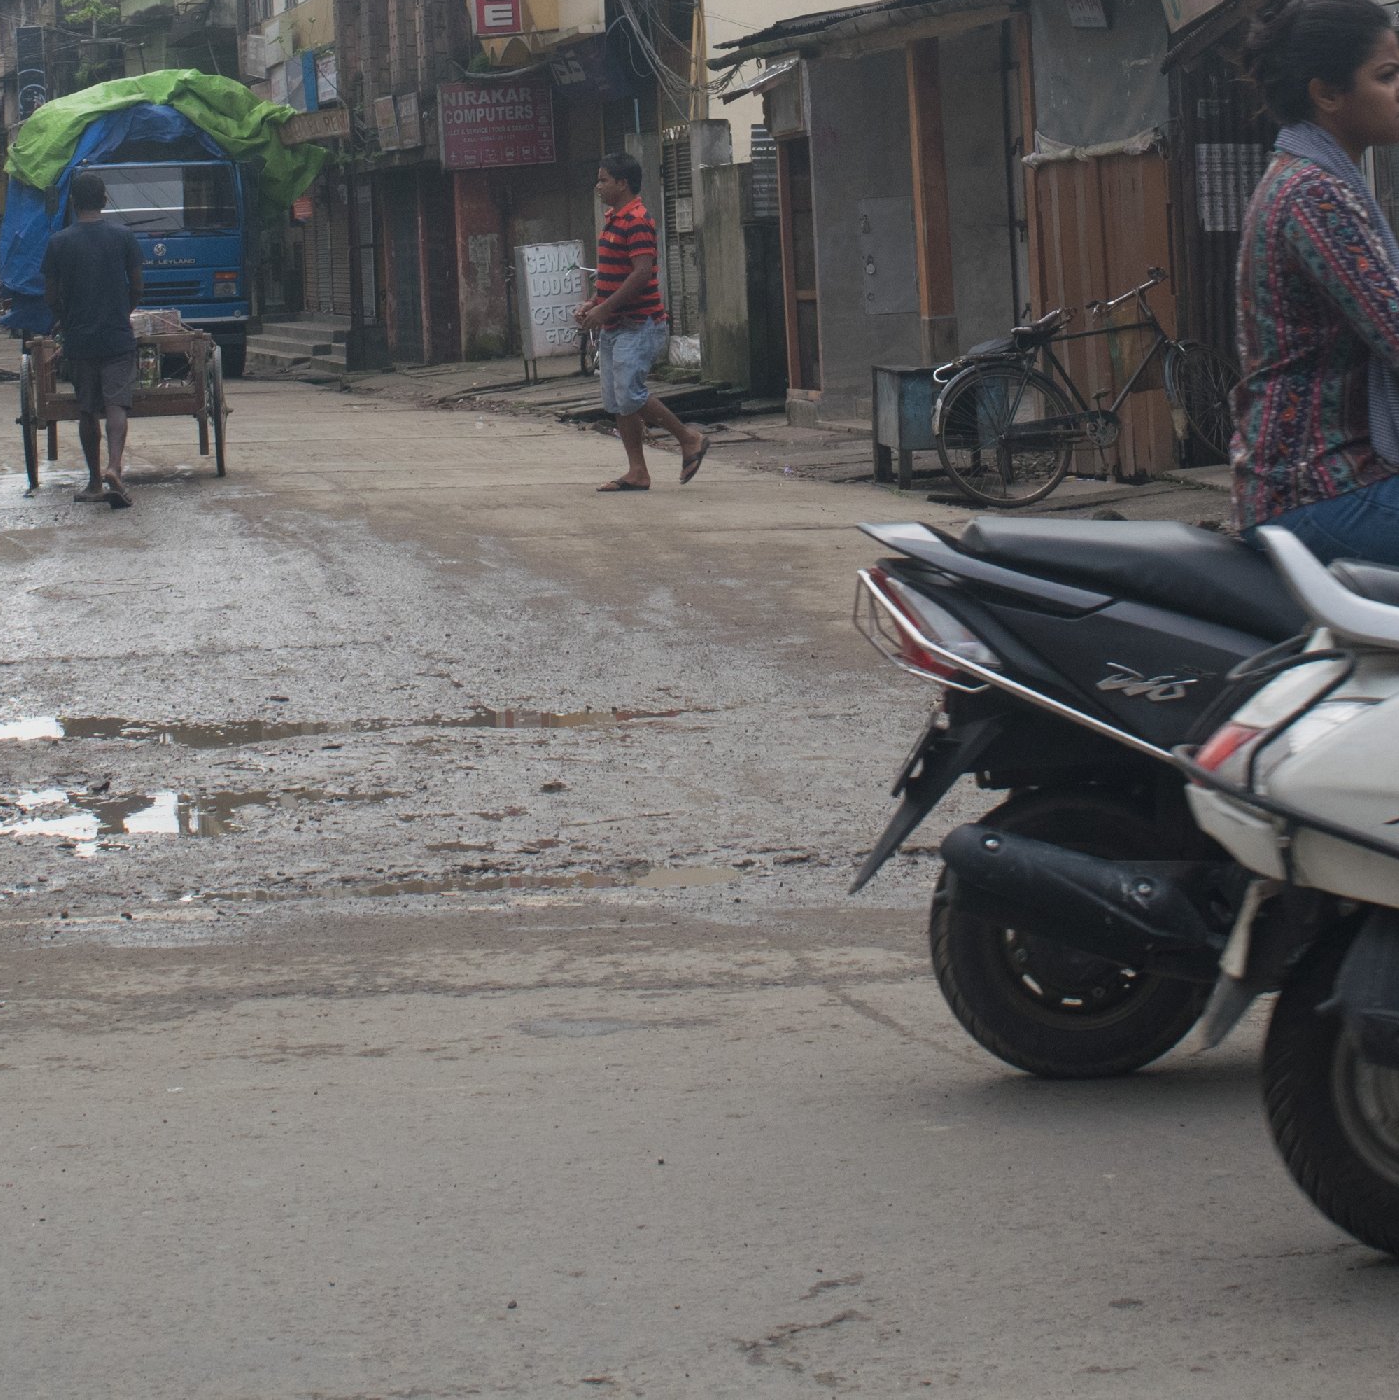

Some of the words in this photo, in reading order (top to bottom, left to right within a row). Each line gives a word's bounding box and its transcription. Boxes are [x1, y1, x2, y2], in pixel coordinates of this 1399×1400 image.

[443, 87, 533, 106] NIRAKAR
[444, 104, 534, 124] COMPUTERS
[158, 257, 196, 265] LEYLAND
[527, 247, 581, 274] SEWAK
[532, 274, 583, 298] LODGE
